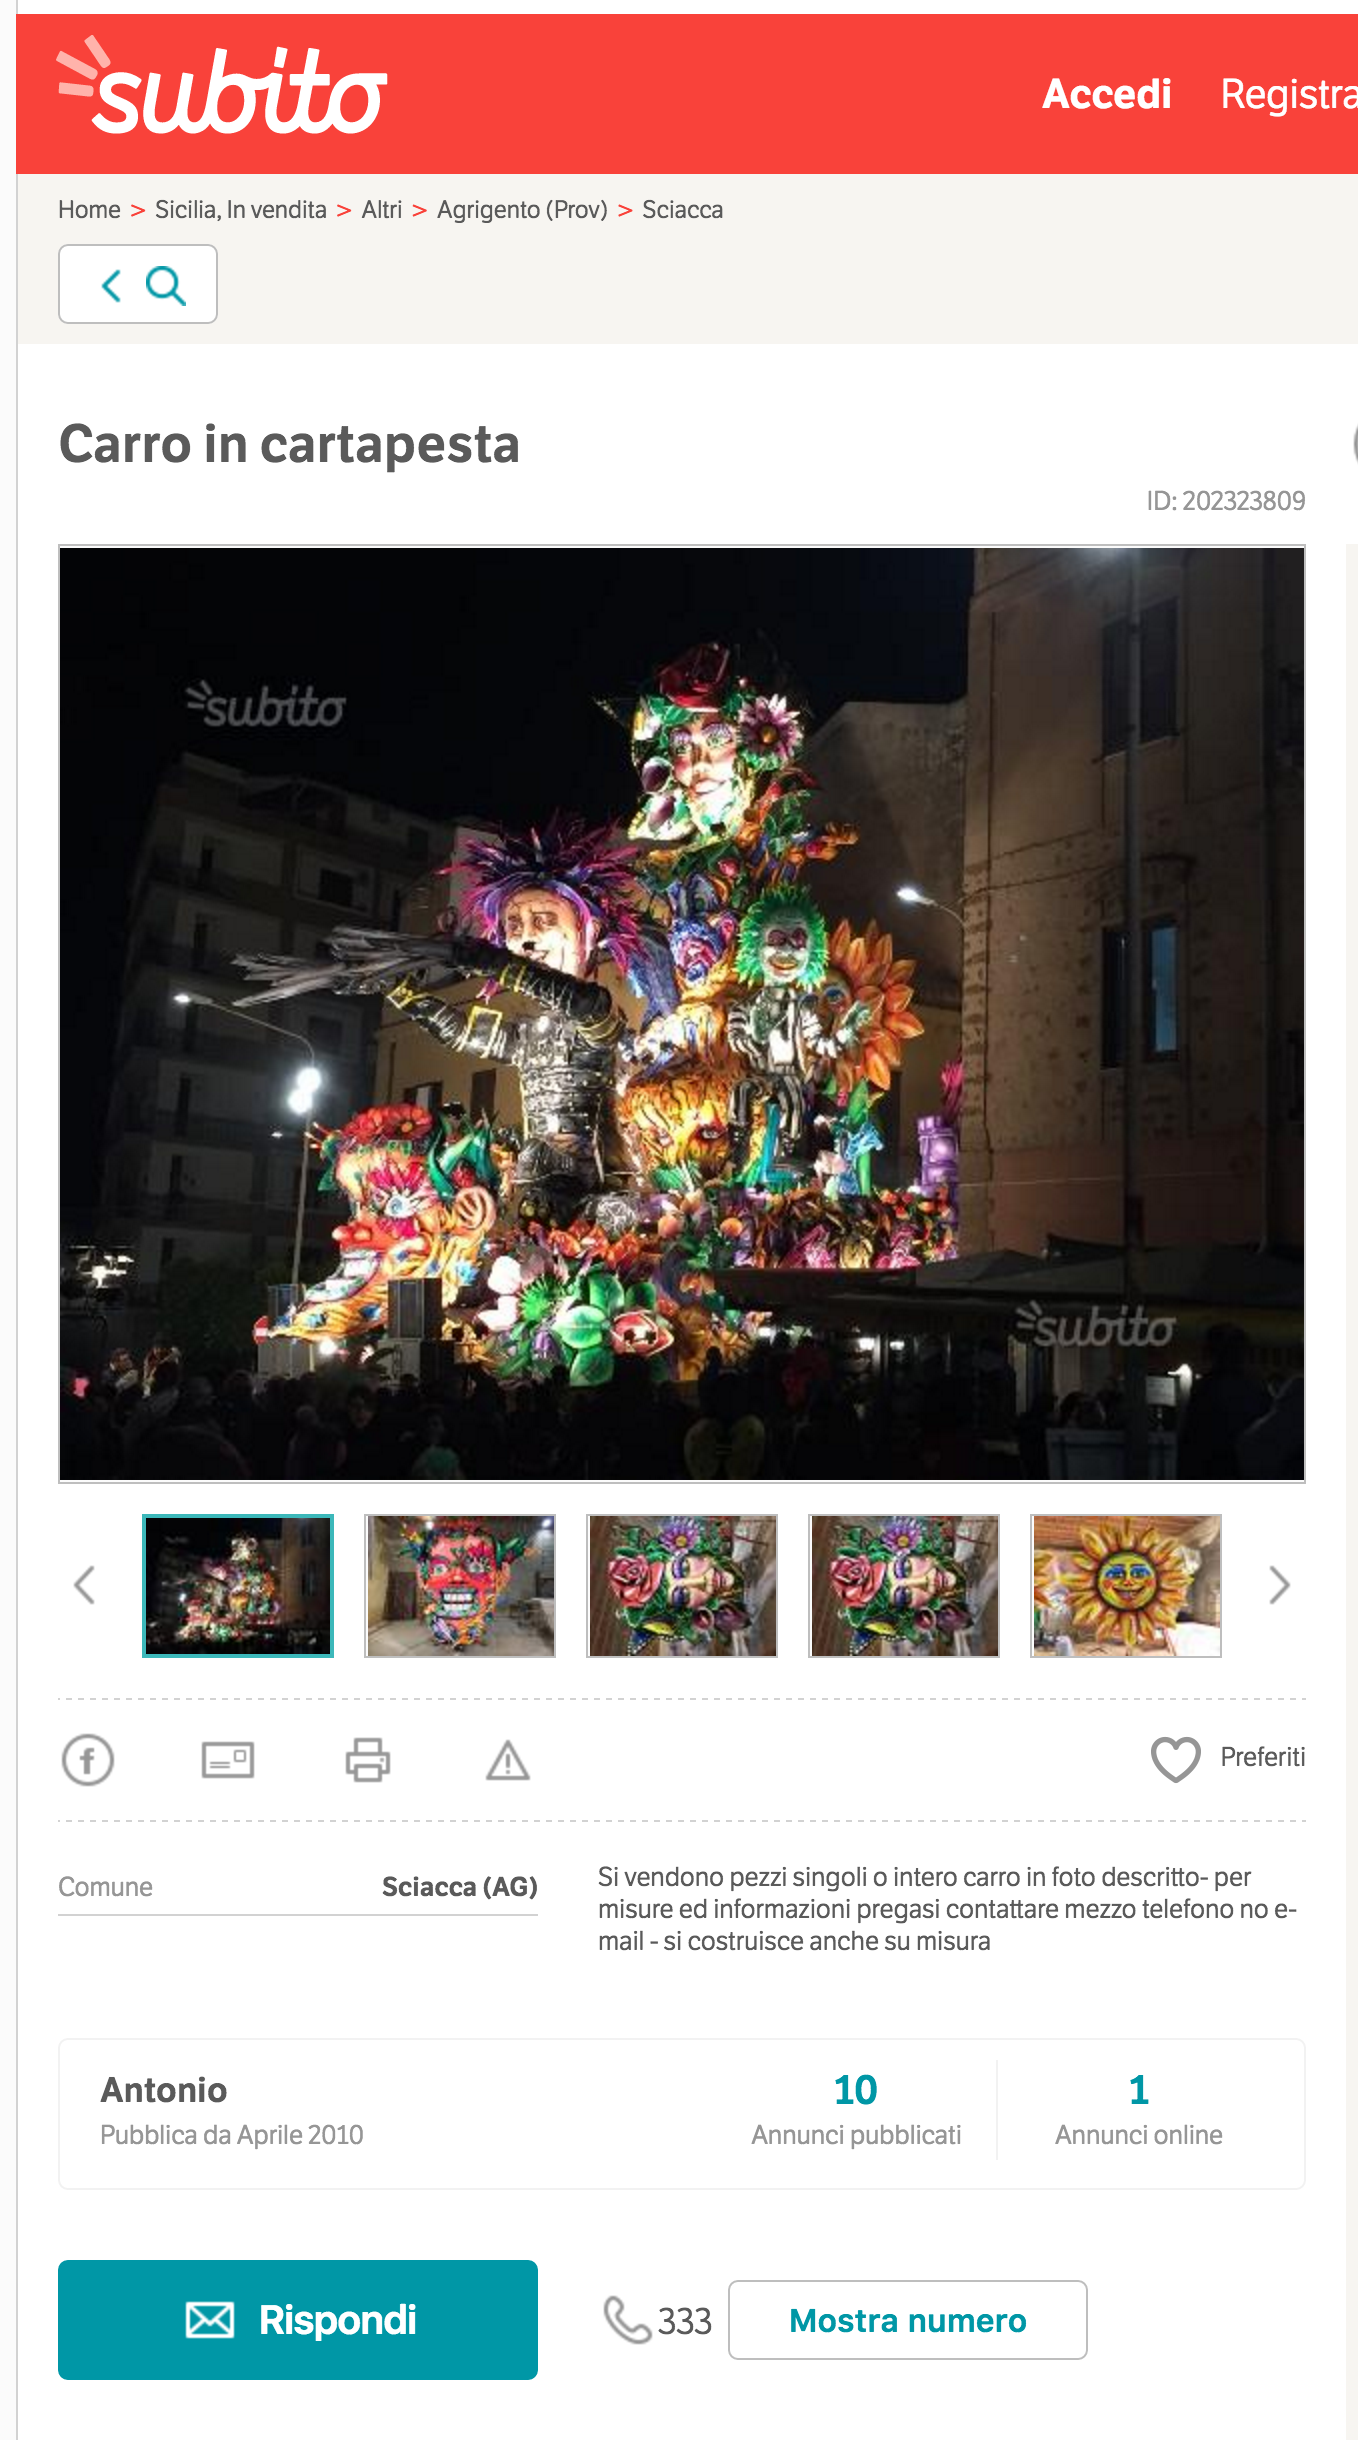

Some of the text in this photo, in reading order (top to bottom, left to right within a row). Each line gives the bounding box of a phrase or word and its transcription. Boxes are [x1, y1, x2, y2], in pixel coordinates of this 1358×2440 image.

[90, 45, 389, 136] subito
[1041, 77, 1172, 110] Accedi
[1222, 77, 1358, 118] Registra
[59, 199, 723, 224] Home Sicilia, In vendita Altri Agrigento (Prov) Sciacca
[59, 422, 519, 473] Carro in cartapesta
[1148, 490, 1306, 511] ID: 202323809
[1221, 1745, 1306, 1767] Preferiti
[58, 1875, 153, 1897] Comune
[382, 1875, 538, 1900] Sciacca (AG)
[598, 1865, 619, 1887] Si
[623, 1866, 724, 1887] vendono
[730, 1866, 787, 1892] pezzi
[792, 1866, 867, 1892] singoli
[873, 1870, 888, 1887] o
[894, 1866, 958, 1887] intero
[963, 1870, 1021, 1887] carro
[1027, 1866, 1046, 1887] in
[1051, 1865, 1096, 1887] foto
[1214, 1870, 1252, 1892] per
[599, 1898, 674, 1919] misure
[679, 1898, 707, 1919] ed
[714, 1897, 851, 1919] informazioni
[857, 1898, 940, 1924] pregasi
[946, 1899, 1059, 1919] contattare
[1065, 1902, 1137, 1919] mezzo
[1141, 1897, 1234, 1919] telefono
[1240, 1902, 1269, 1919] no
[599, 1930, 644, 1951] mail
[663, 1930, 682, 1951] si
[687, 1930, 804, 1951] costruisce
[809, 1930, 879, 1951] anche
[884, 1934, 910, 1951] su
[917, 1930, 991, 1951] misura
[99, 2076, 228, 2103] Antonio
[834, 2073, 878, 2106] 10
[1129, 2074, 1150, 2105] 1
[101, 2124, 364, 2150] Pubblica da Aprile 2010
[751, 2124, 961, 2150] Annunci pubblicati
[1054, 2124, 1223, 2145] Annunci online
[260, 2302, 417, 2342] Rispondi
[657, 2306, 712, 2335] 333
[790, 2308, 1027, 2334] Mostra numero
